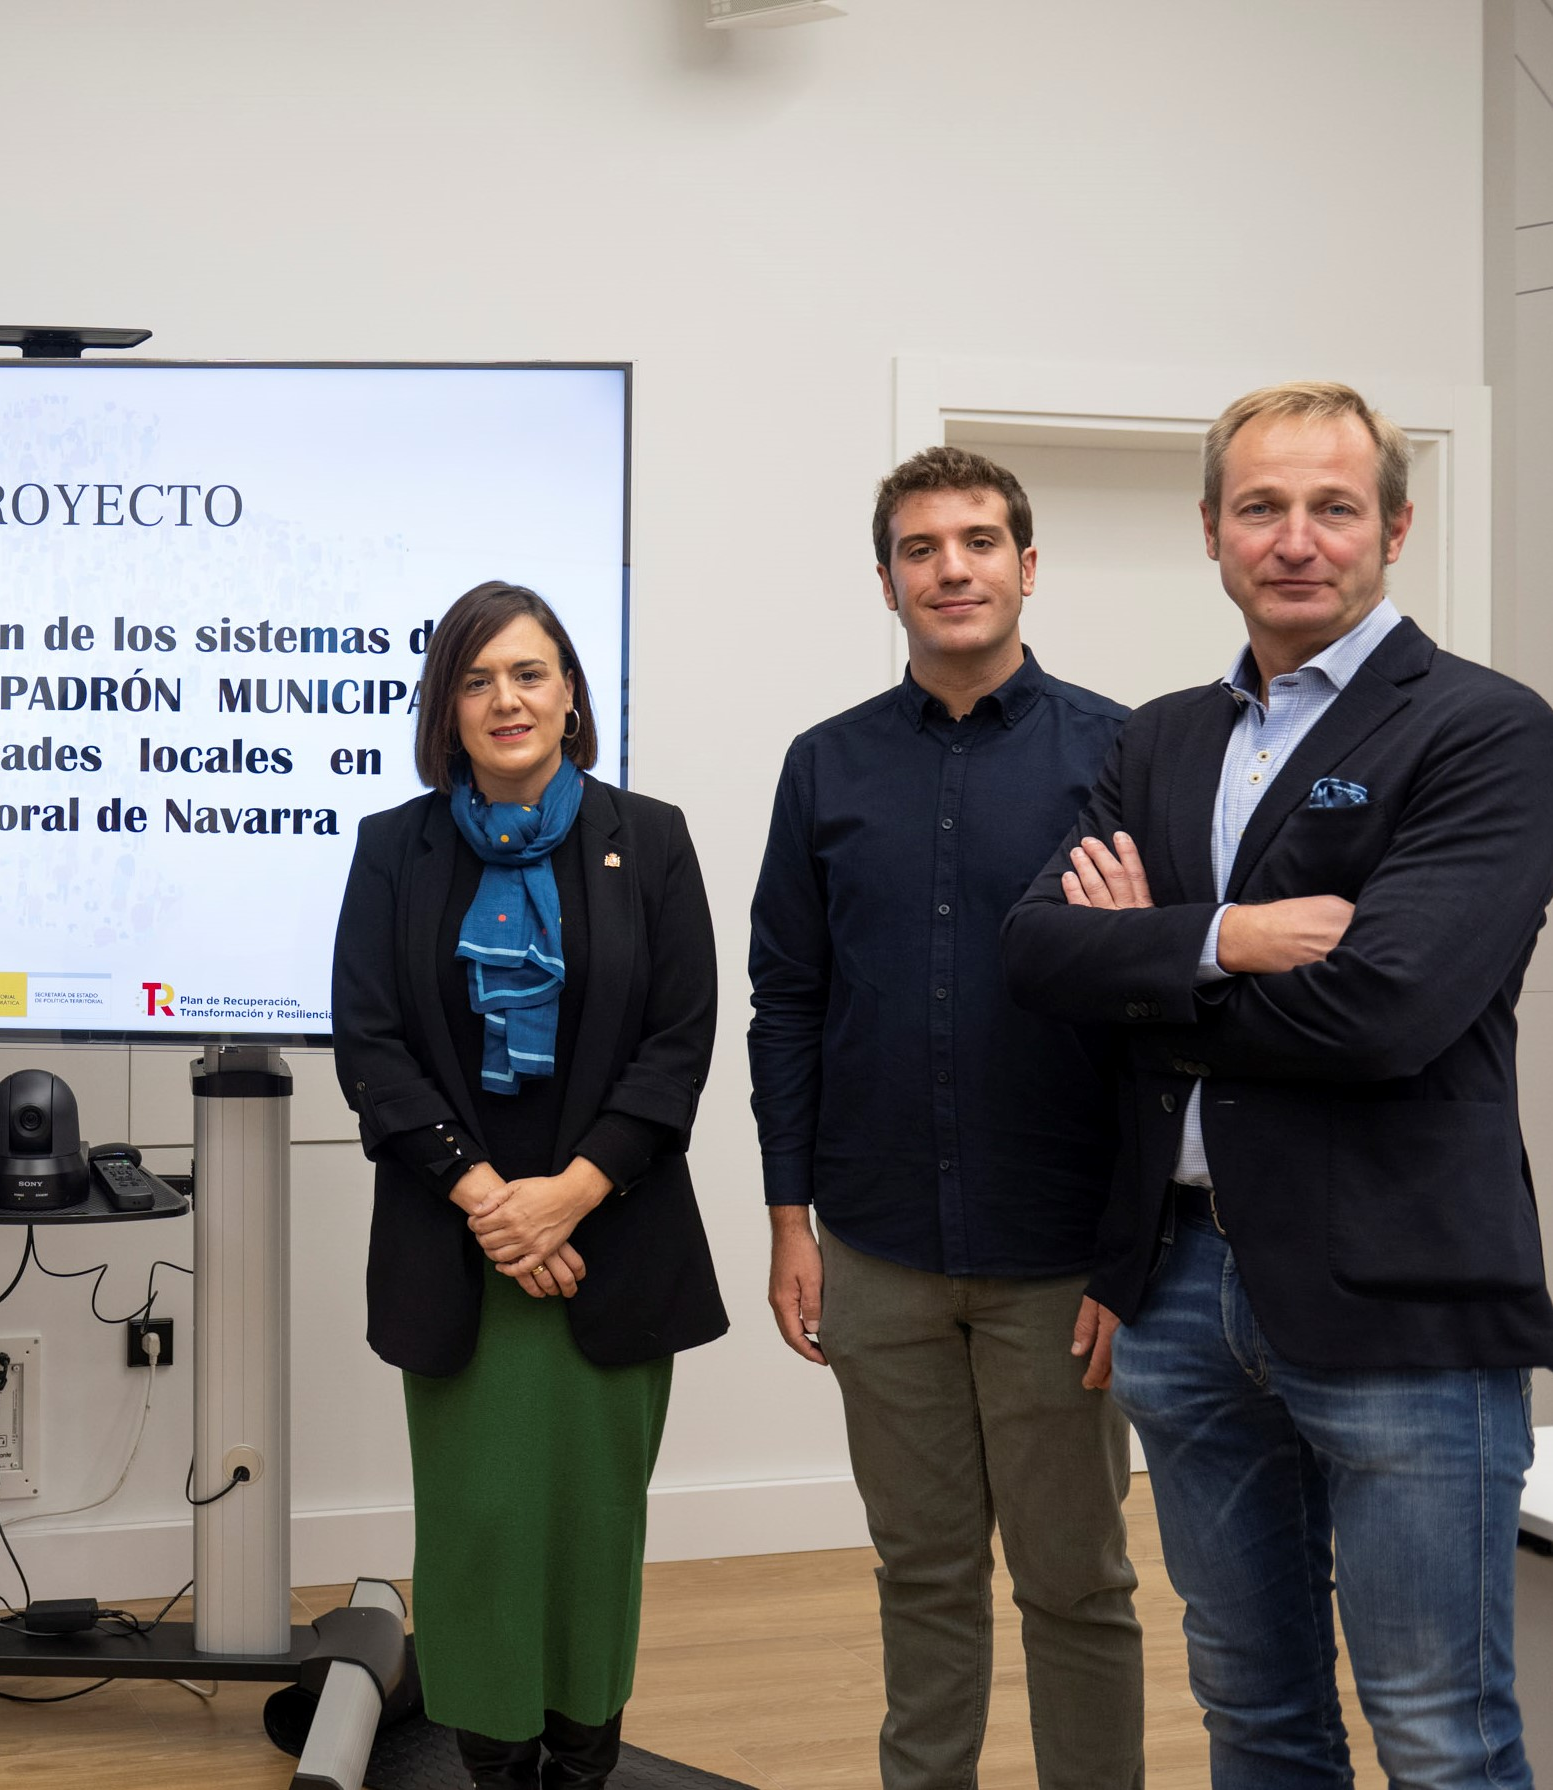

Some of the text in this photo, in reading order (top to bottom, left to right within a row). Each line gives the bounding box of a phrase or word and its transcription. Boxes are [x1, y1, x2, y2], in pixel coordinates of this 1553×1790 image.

[44, 616, 94, 651] de
[115, 617, 176, 652] los
[195, 617, 390, 654] sistemas
[1, 668, 180, 712] PADRÓN
[140, 738, 293, 774] locales
[331, 749, 381, 775] en
[97, 798, 147, 832] de
[166, 799, 340, 835] Navarra
[180, 996, 300, 1007] Plan de Recuperación,
[180, 1008, 264, 1018] Transformación
[267, 1011, 274, 1019] y
